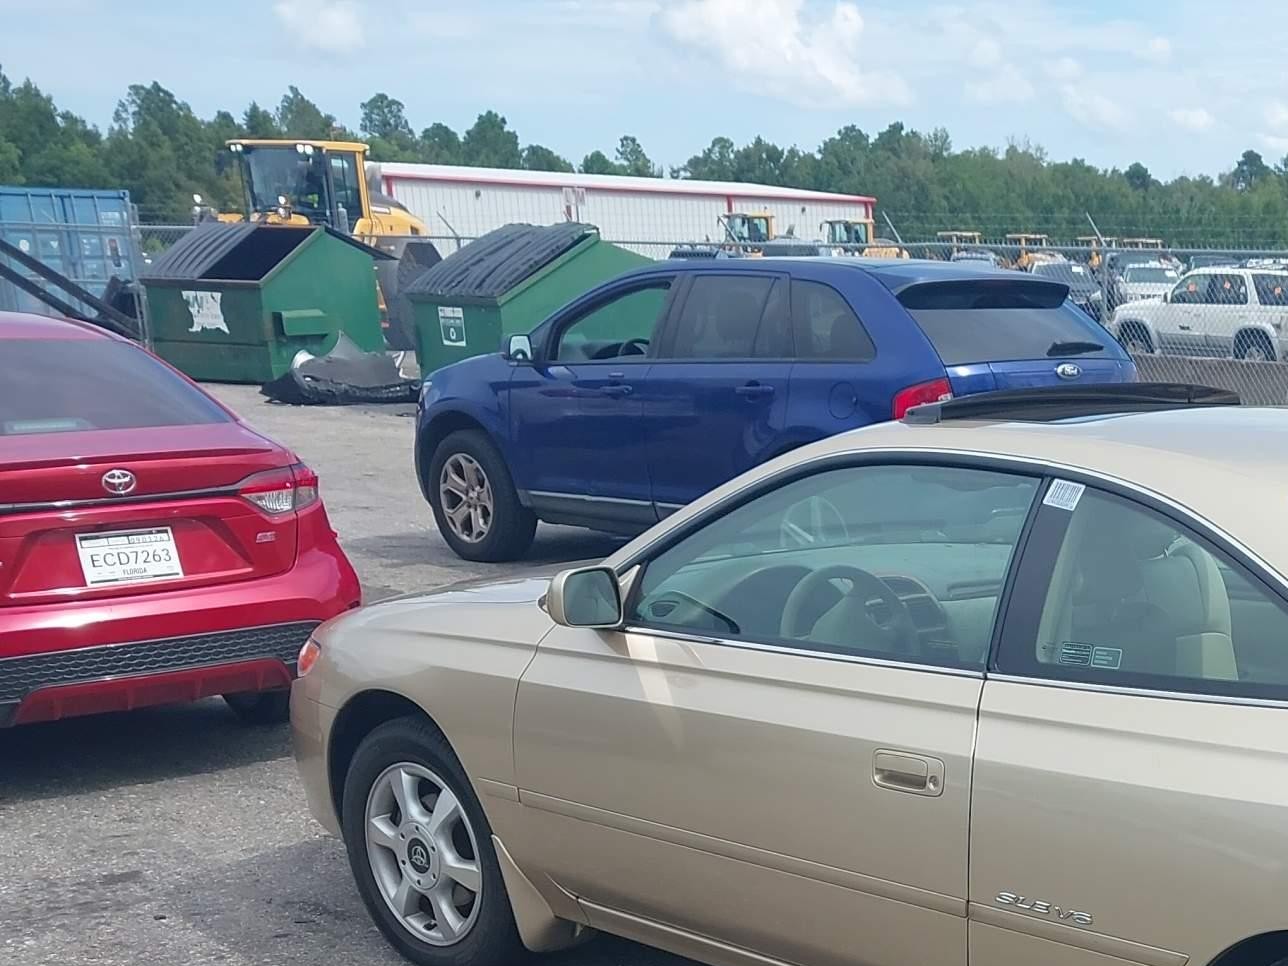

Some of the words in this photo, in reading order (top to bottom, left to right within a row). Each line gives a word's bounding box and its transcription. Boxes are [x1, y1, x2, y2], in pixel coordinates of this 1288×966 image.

[90, 548, 172, 568] ECD7263
[122, 567, 147, 576] FLORIDA
[995, 892, 1050, 914] SLE
[1054, 905, 1093, 925] V6
